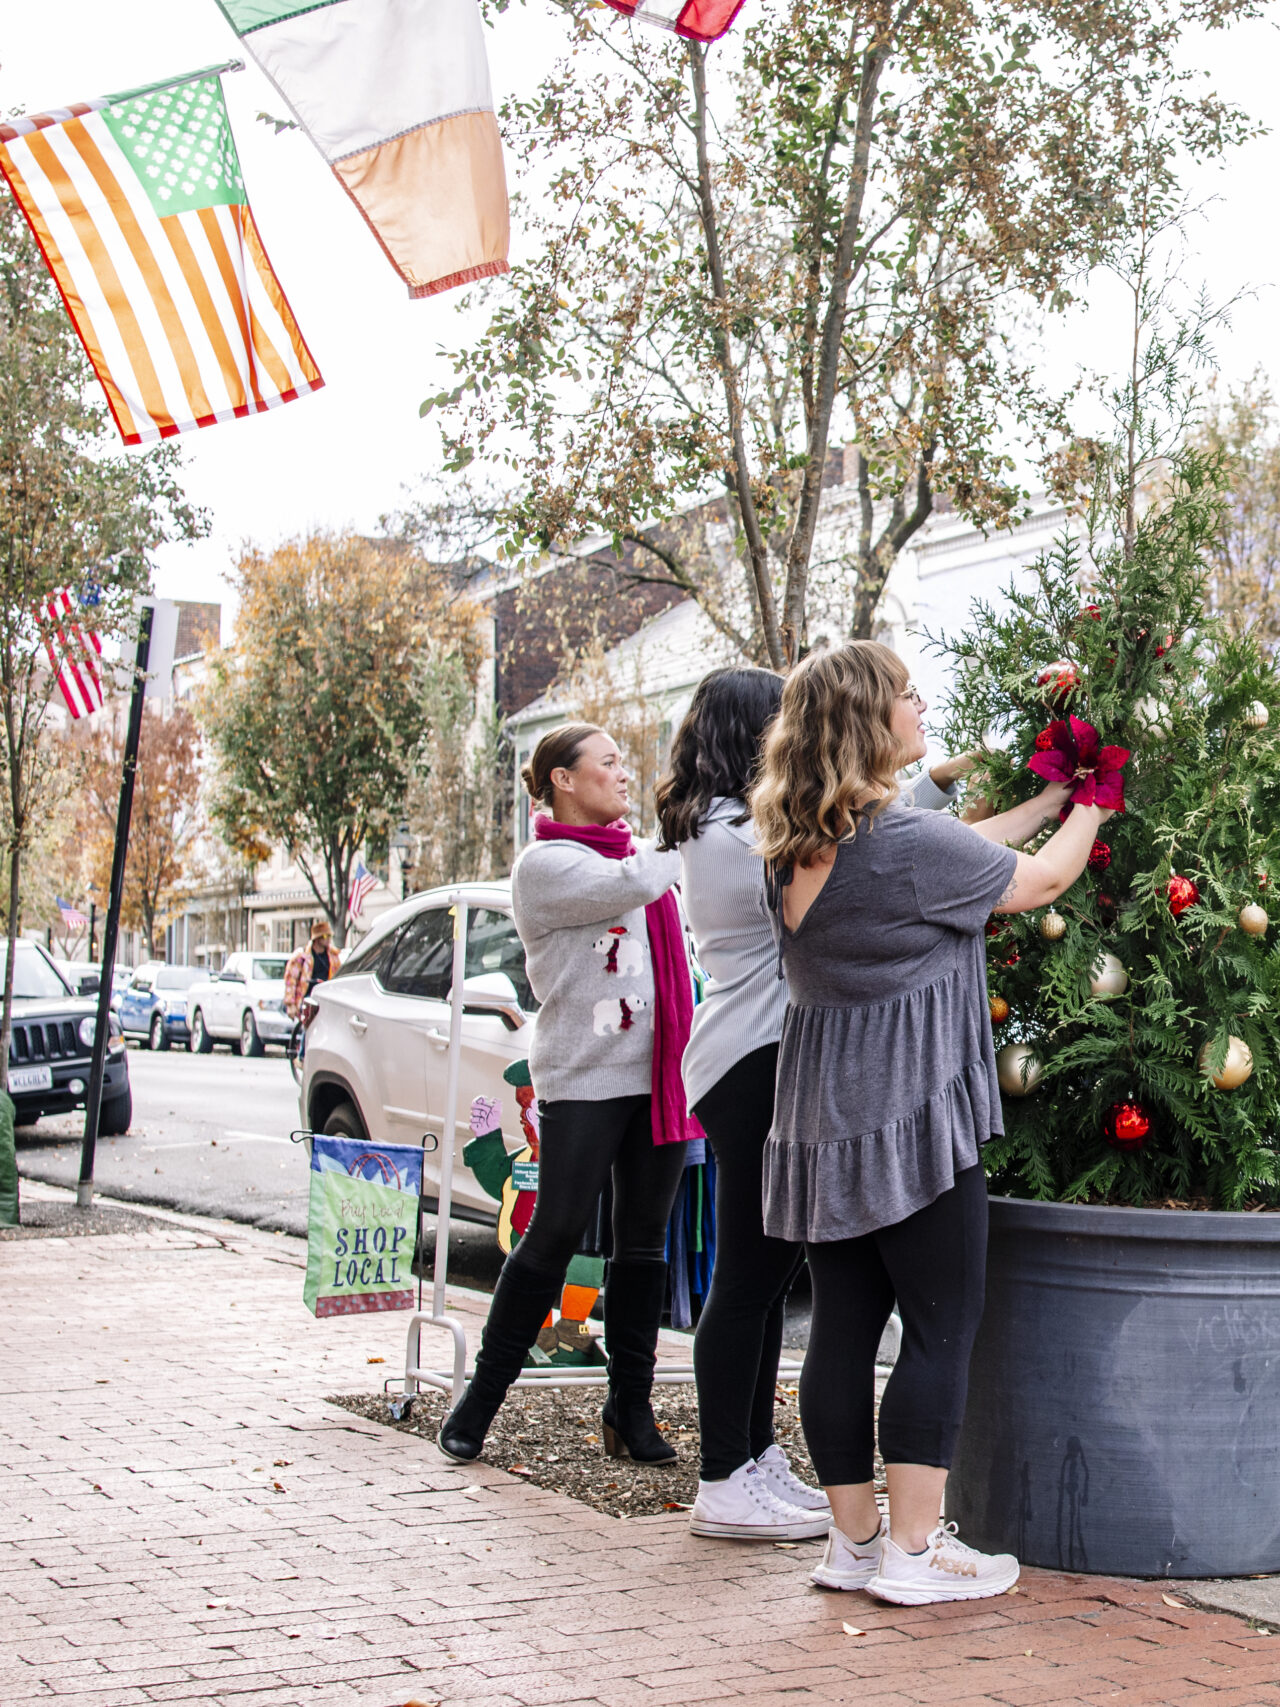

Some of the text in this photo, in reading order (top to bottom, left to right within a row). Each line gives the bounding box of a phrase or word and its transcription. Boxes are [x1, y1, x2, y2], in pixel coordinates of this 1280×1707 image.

[341, 1199, 405, 1225] Buy Local
[335, 1226, 407, 1256] SHOP
[333, 1257, 401, 1287] LOCAL
[928, 1554, 977, 1578] HOKA
